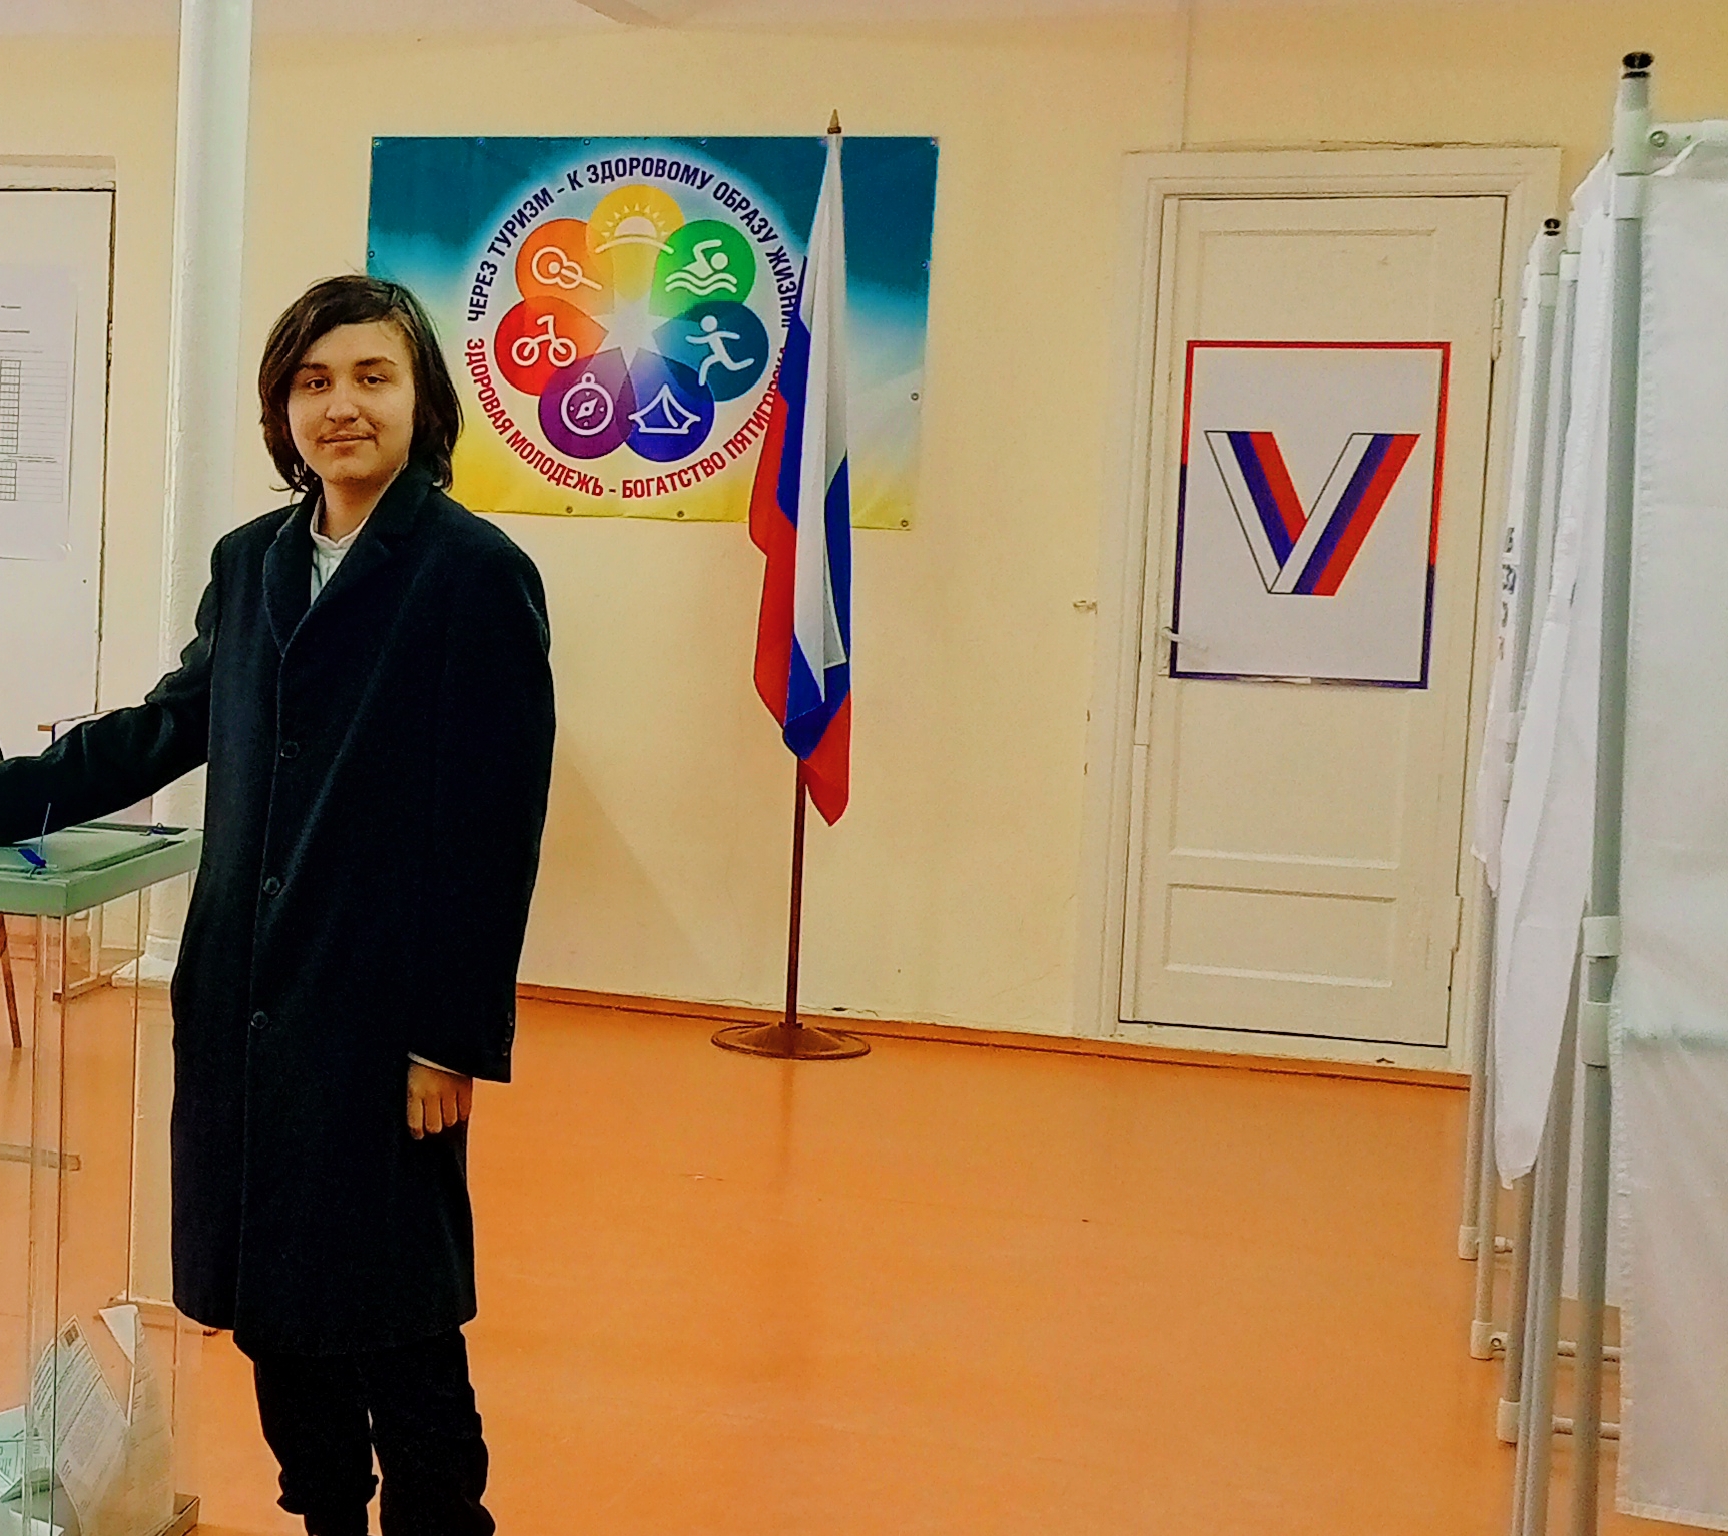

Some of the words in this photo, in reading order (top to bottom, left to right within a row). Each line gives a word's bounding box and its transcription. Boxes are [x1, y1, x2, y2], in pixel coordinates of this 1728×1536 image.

[467, 260, 498, 322] ЧЕРЕЗ
[487, 187, 555, 257] ТУРИЗМ
[567, 170, 584, 191] К
[586, 157, 714, 190] ЗДОРОВОМУ
[712, 181, 778, 244] ОБРАЗУ
[465, 338, 514, 436] ЗДОРОВАЯ
[505, 429, 604, 497] МОЛОДЕЖЬ
[622, 451, 727, 498] БОГАТСТВО
